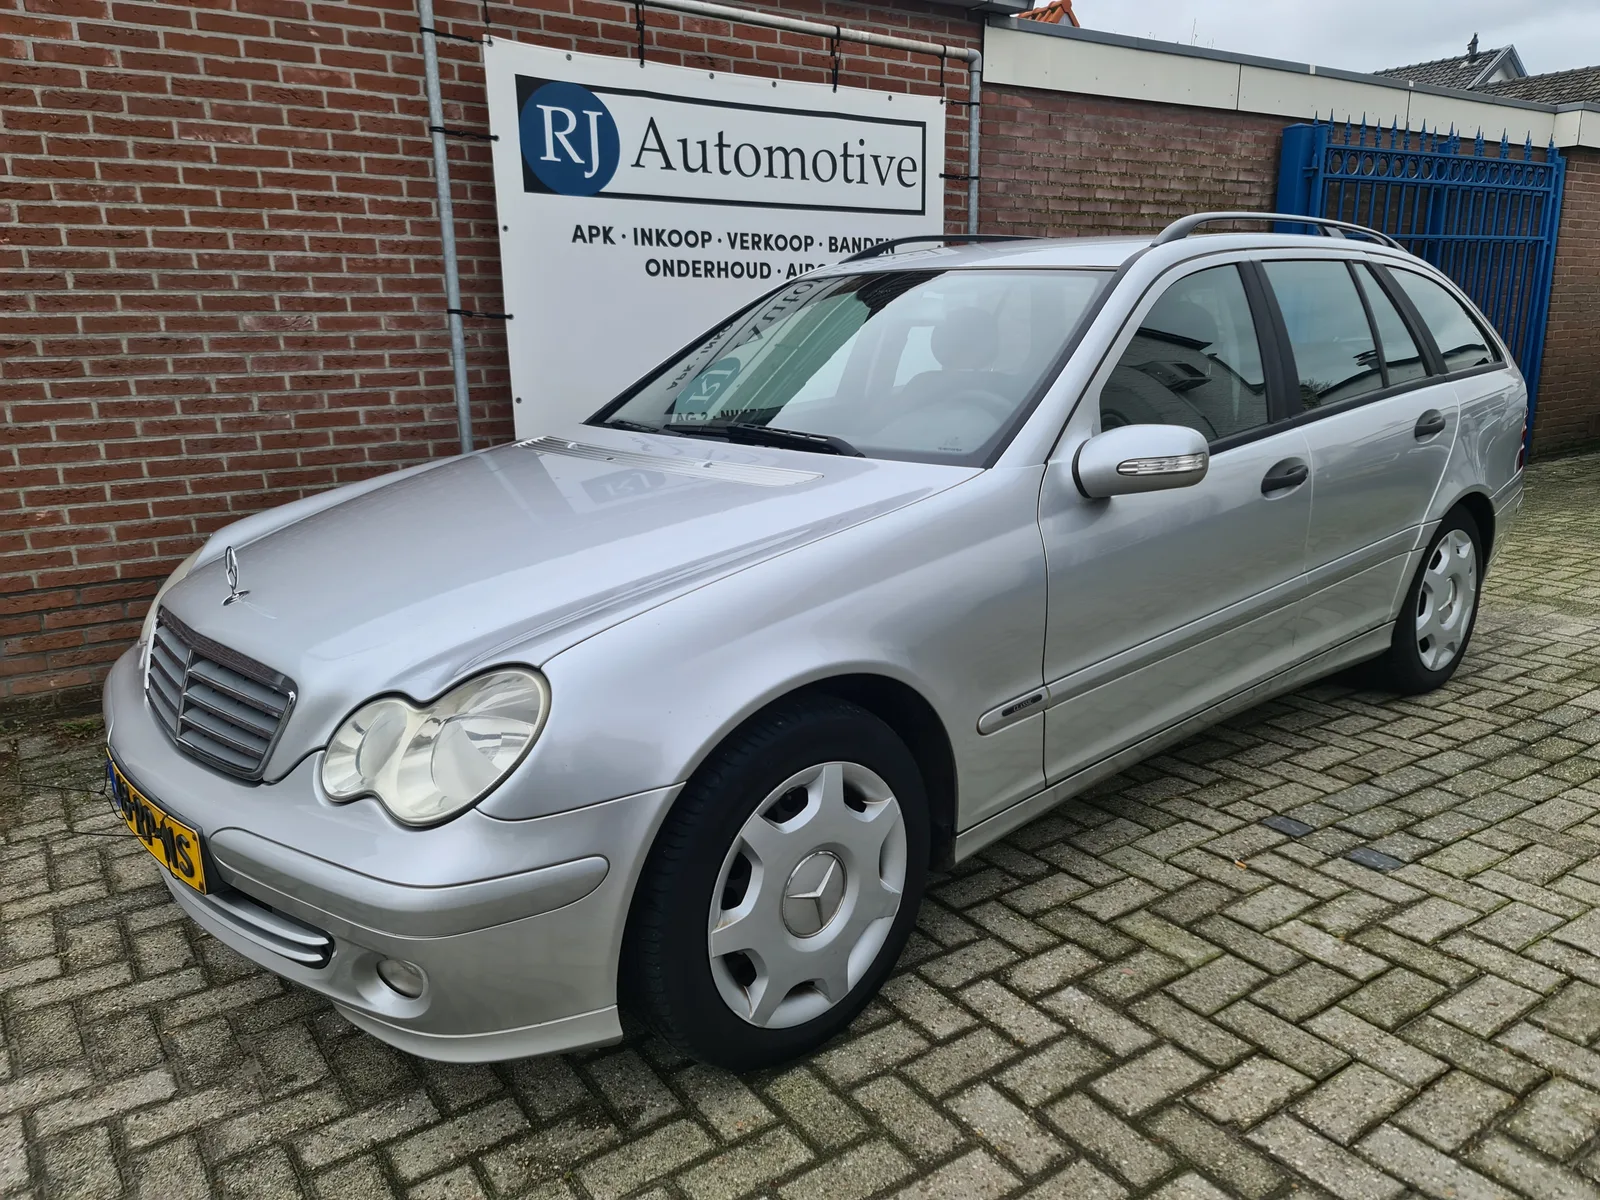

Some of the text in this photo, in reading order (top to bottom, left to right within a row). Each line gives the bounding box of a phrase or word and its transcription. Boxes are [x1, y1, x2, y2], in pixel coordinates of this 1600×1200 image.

[536, 104, 918, 188] RJ Automotive
[571, 224, 616, 245] APK
[633, 227, 712, 248] INKOOP
[726, 231, 815, 252] VERKOOP
[645, 258, 771, 280] ONDERHOUD
